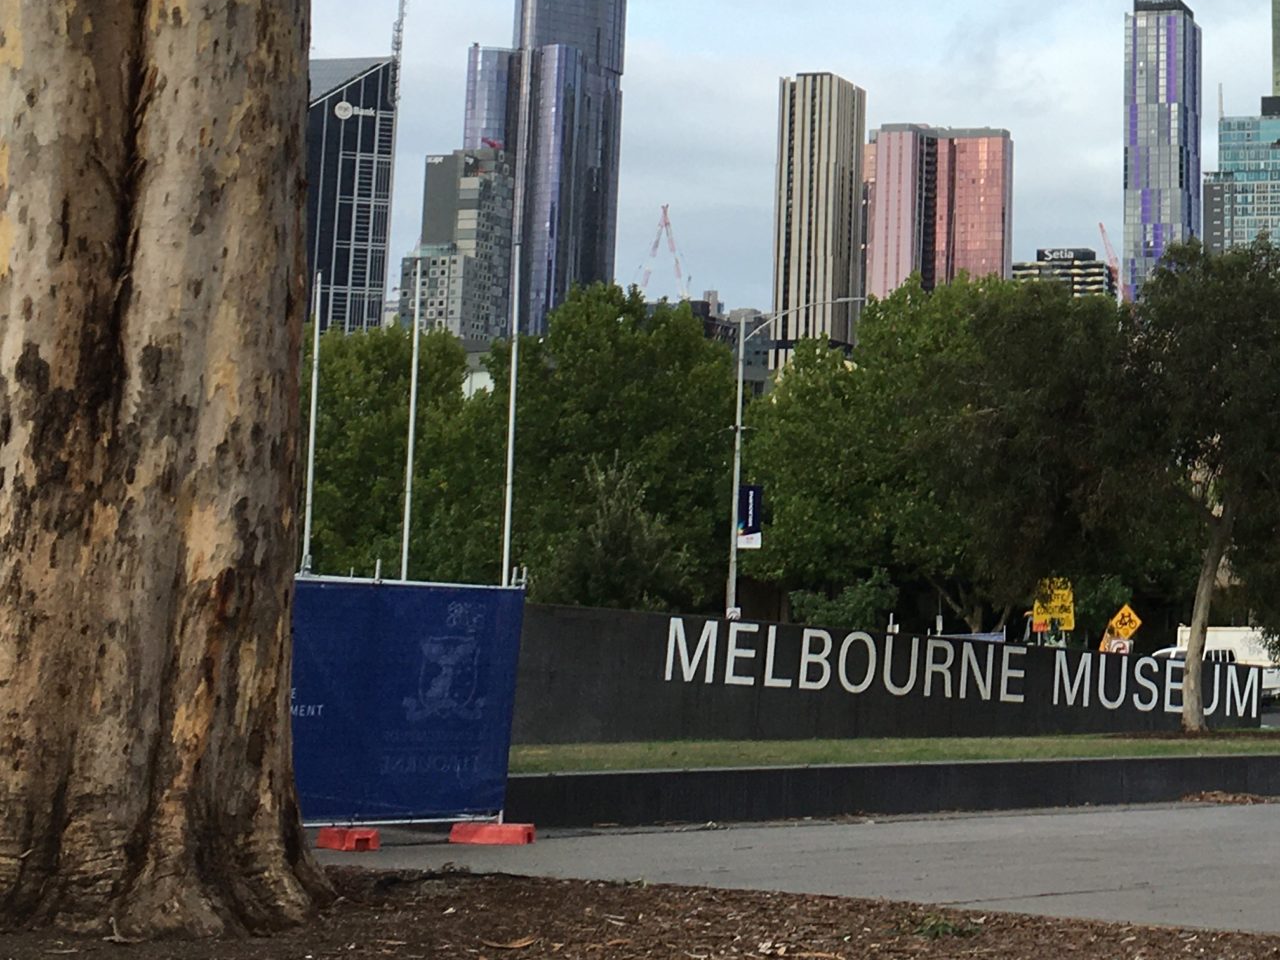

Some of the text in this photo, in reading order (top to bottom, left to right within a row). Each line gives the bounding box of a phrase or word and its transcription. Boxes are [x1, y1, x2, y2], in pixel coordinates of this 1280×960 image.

[353, 106, 375, 117] Bank
[1044, 249, 1075, 260] Setia
[665, 617, 1263, 718] MELBOURNE MUSEUM
